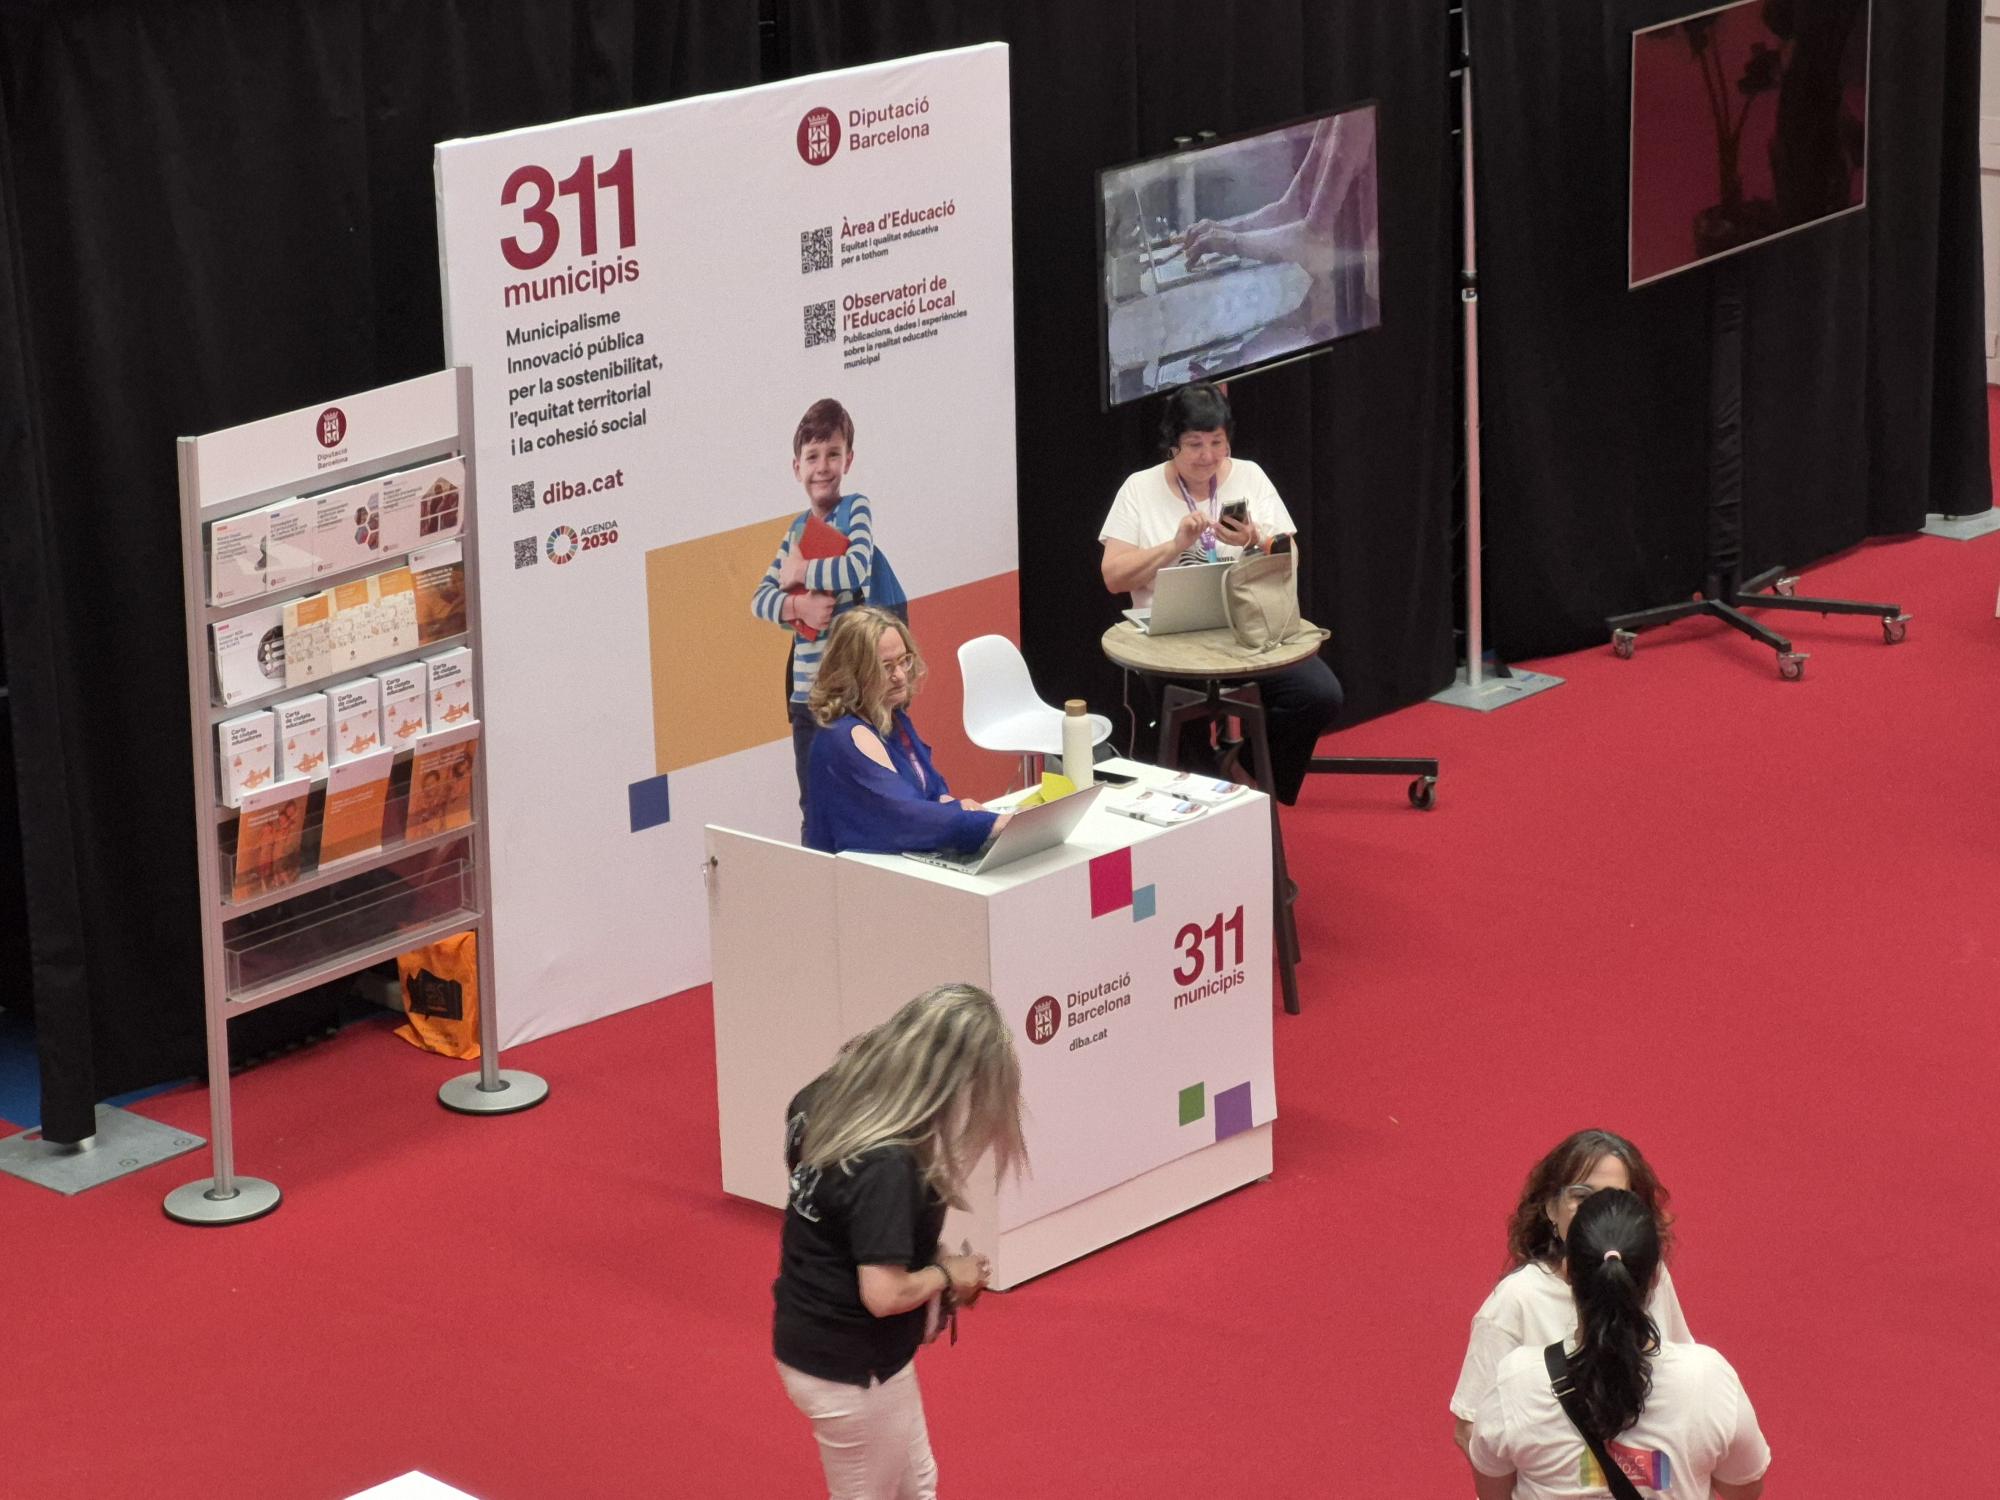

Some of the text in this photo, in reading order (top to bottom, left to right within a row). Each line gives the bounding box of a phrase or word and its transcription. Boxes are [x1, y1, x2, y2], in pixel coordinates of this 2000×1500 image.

[849, 96, 930, 128] Diputació
[849, 123, 930, 151] Barcelona
[500, 147, 636, 271] 311
[840, 199, 955, 239] Àrea d'Educació
[841, 240, 868, 254] Equitat
[872, 232, 901, 247] qualitat
[902, 224, 939, 241] educativa
[841, 257, 854, 268] per
[861, 248, 889, 262] tothom
[504, 255, 640, 308] municipis
[842, 275, 947, 311] Observatori de
[506, 310, 621, 347] Municipalisme
[843, 290, 956, 331] l'Educació Local
[843, 327, 893, 345] Publicacions,
[893, 321, 917, 333] dades
[921, 309, 968, 328] experiències
[507, 331, 644, 374] Innovació pública
[843, 328, 938, 357] sobre la realitat educativa
[843, 352, 880, 370] municipal
[508, 354, 663, 406] per la sostenibilitat,
[510, 380, 651, 429] l'equitat territorial
[511, 408, 646, 456] i la cohesió social
[317, 448, 348, 461] Diputació
[317, 456, 348, 469] Barcelona
[542, 469, 624, 505] diba.cat
[580, 519, 618, 537] AGENDA
[581, 530, 619, 551] 2030
[1173, 904, 1244, 987] 311
[1067, 972, 1131, 1009] Diputació
[1173, 968, 1245, 1010] municipis
[1067, 993, 1131, 1028] Barcelona
[1069, 1028, 1108, 1052] diba.cat
